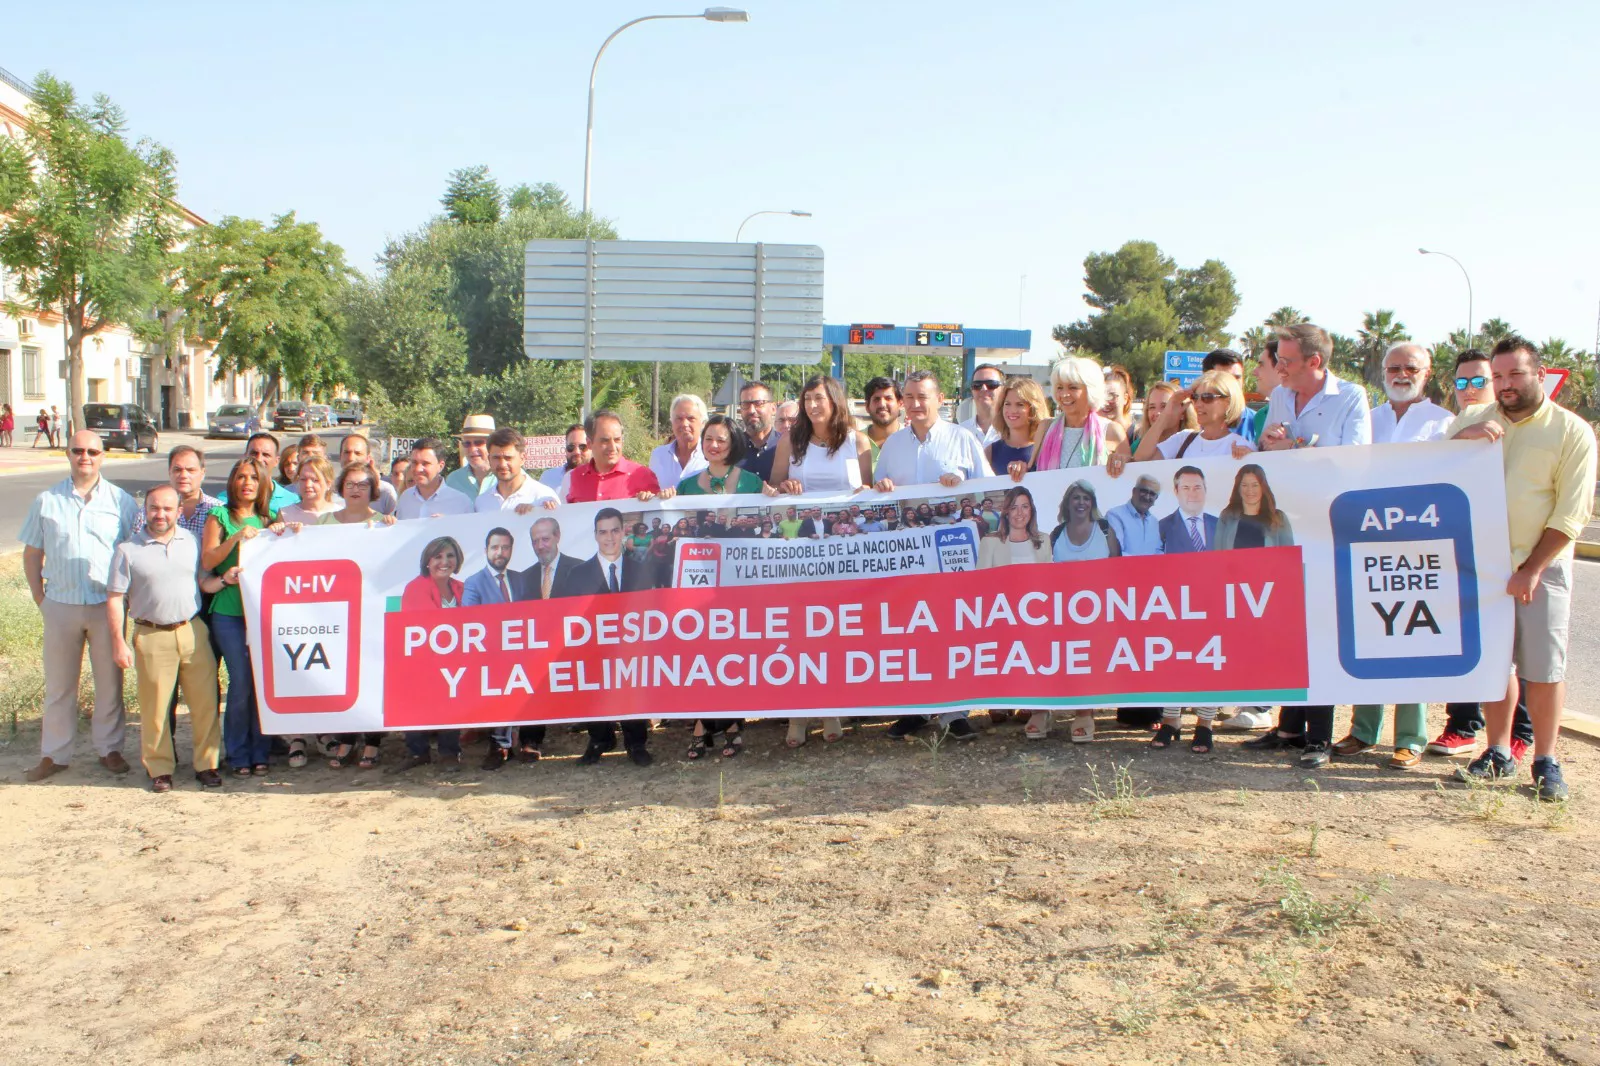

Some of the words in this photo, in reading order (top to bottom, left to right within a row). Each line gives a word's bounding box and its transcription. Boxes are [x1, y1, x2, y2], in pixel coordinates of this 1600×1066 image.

[1360, 503, 1440, 532] AP-4
[725, 546, 748, 561] POR
[751, 548, 765, 561] EL
[767, 545, 826, 560] DESDOBLE
[828, 543, 843, 557] DE
[846, 541, 861, 555] LA
[863, 537, 920, 554] NACIONAL
[921, 534, 932, 548] IV
[939, 533, 968, 543] AP-4
[688, 547, 714, 556] N-IV
[941, 548, 970, 557] PEAJE
[944, 557, 970, 565] LIBRE
[735, 564, 743, 579] Y
[745, 564, 759, 579] LA
[761, 557, 835, 579] ELIMINACIÓN
[838, 559, 860, 574] DEL
[862, 556, 898, 574] PEAJE
[900, 554, 925, 570] AP-4
[1364, 554, 1442, 572] PEAJE
[284, 574, 337, 595] N-IV
[689, 574, 709, 585] YA
[1368, 573, 1440, 593] LIBRE
[403, 621, 487, 657] POR
[500, 618, 549, 652] EL
[563, 606, 790, 648] DESDOBLE
[805, 602, 864, 639] DE
[880, 600, 939, 635] LA
[954, 584, 1208, 632] NACIONAL
[1225, 580, 1275, 619] IV
[1371, 600, 1442, 637] YA
[277, 624, 341, 636] DESDOBLE
[282, 642, 331, 672] YA
[440, 666, 468, 699] Y
[480, 662, 535, 698] LA
[548, 644, 828, 694] ELIMINACIÓN
[845, 647, 932, 684] DEL
[948, 639, 1093, 680] PEAJE
[1106, 635, 1228, 673] AP-4
